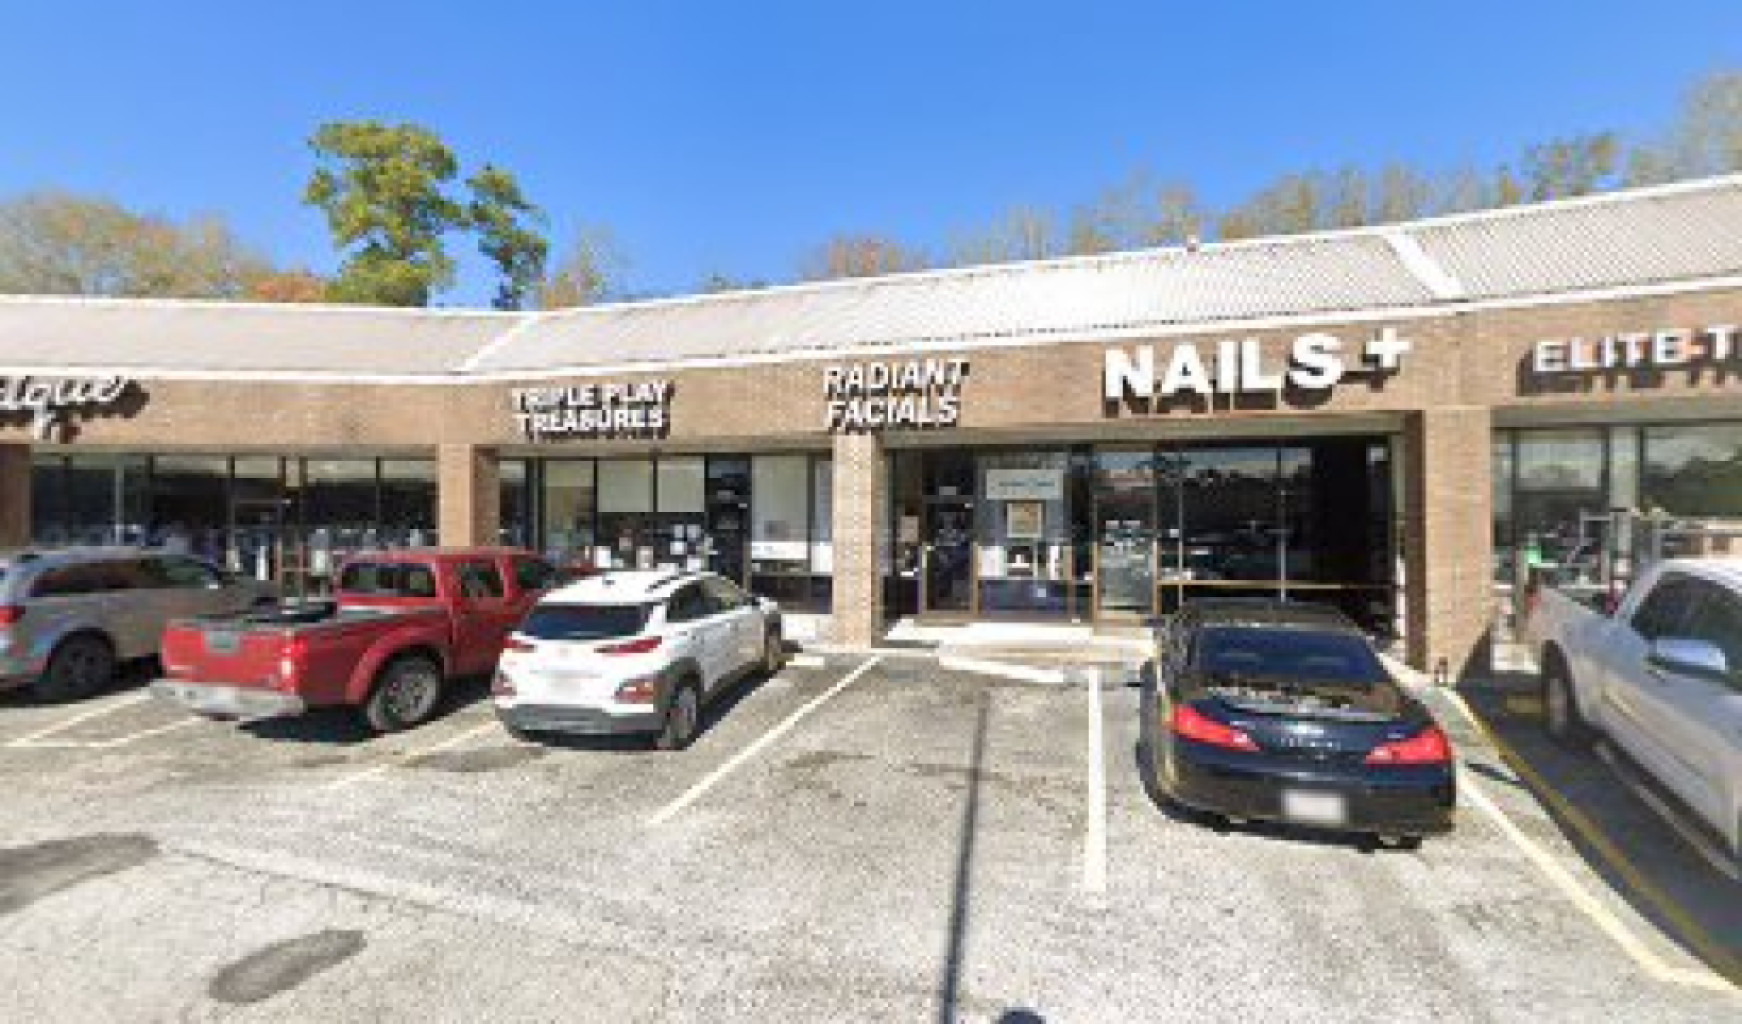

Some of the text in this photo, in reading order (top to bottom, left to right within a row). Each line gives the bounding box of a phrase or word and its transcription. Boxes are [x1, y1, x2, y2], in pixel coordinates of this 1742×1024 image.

[1104, 332, 1342, 399] NAILS
[1532, 331, 1692, 372] ELITE
[824, 358, 970, 394] RADIANT
[511, 382, 668, 412] TRIPLE PLAY
[825, 396, 957, 432] FACIALS
[511, 408, 664, 435] TREASURES
